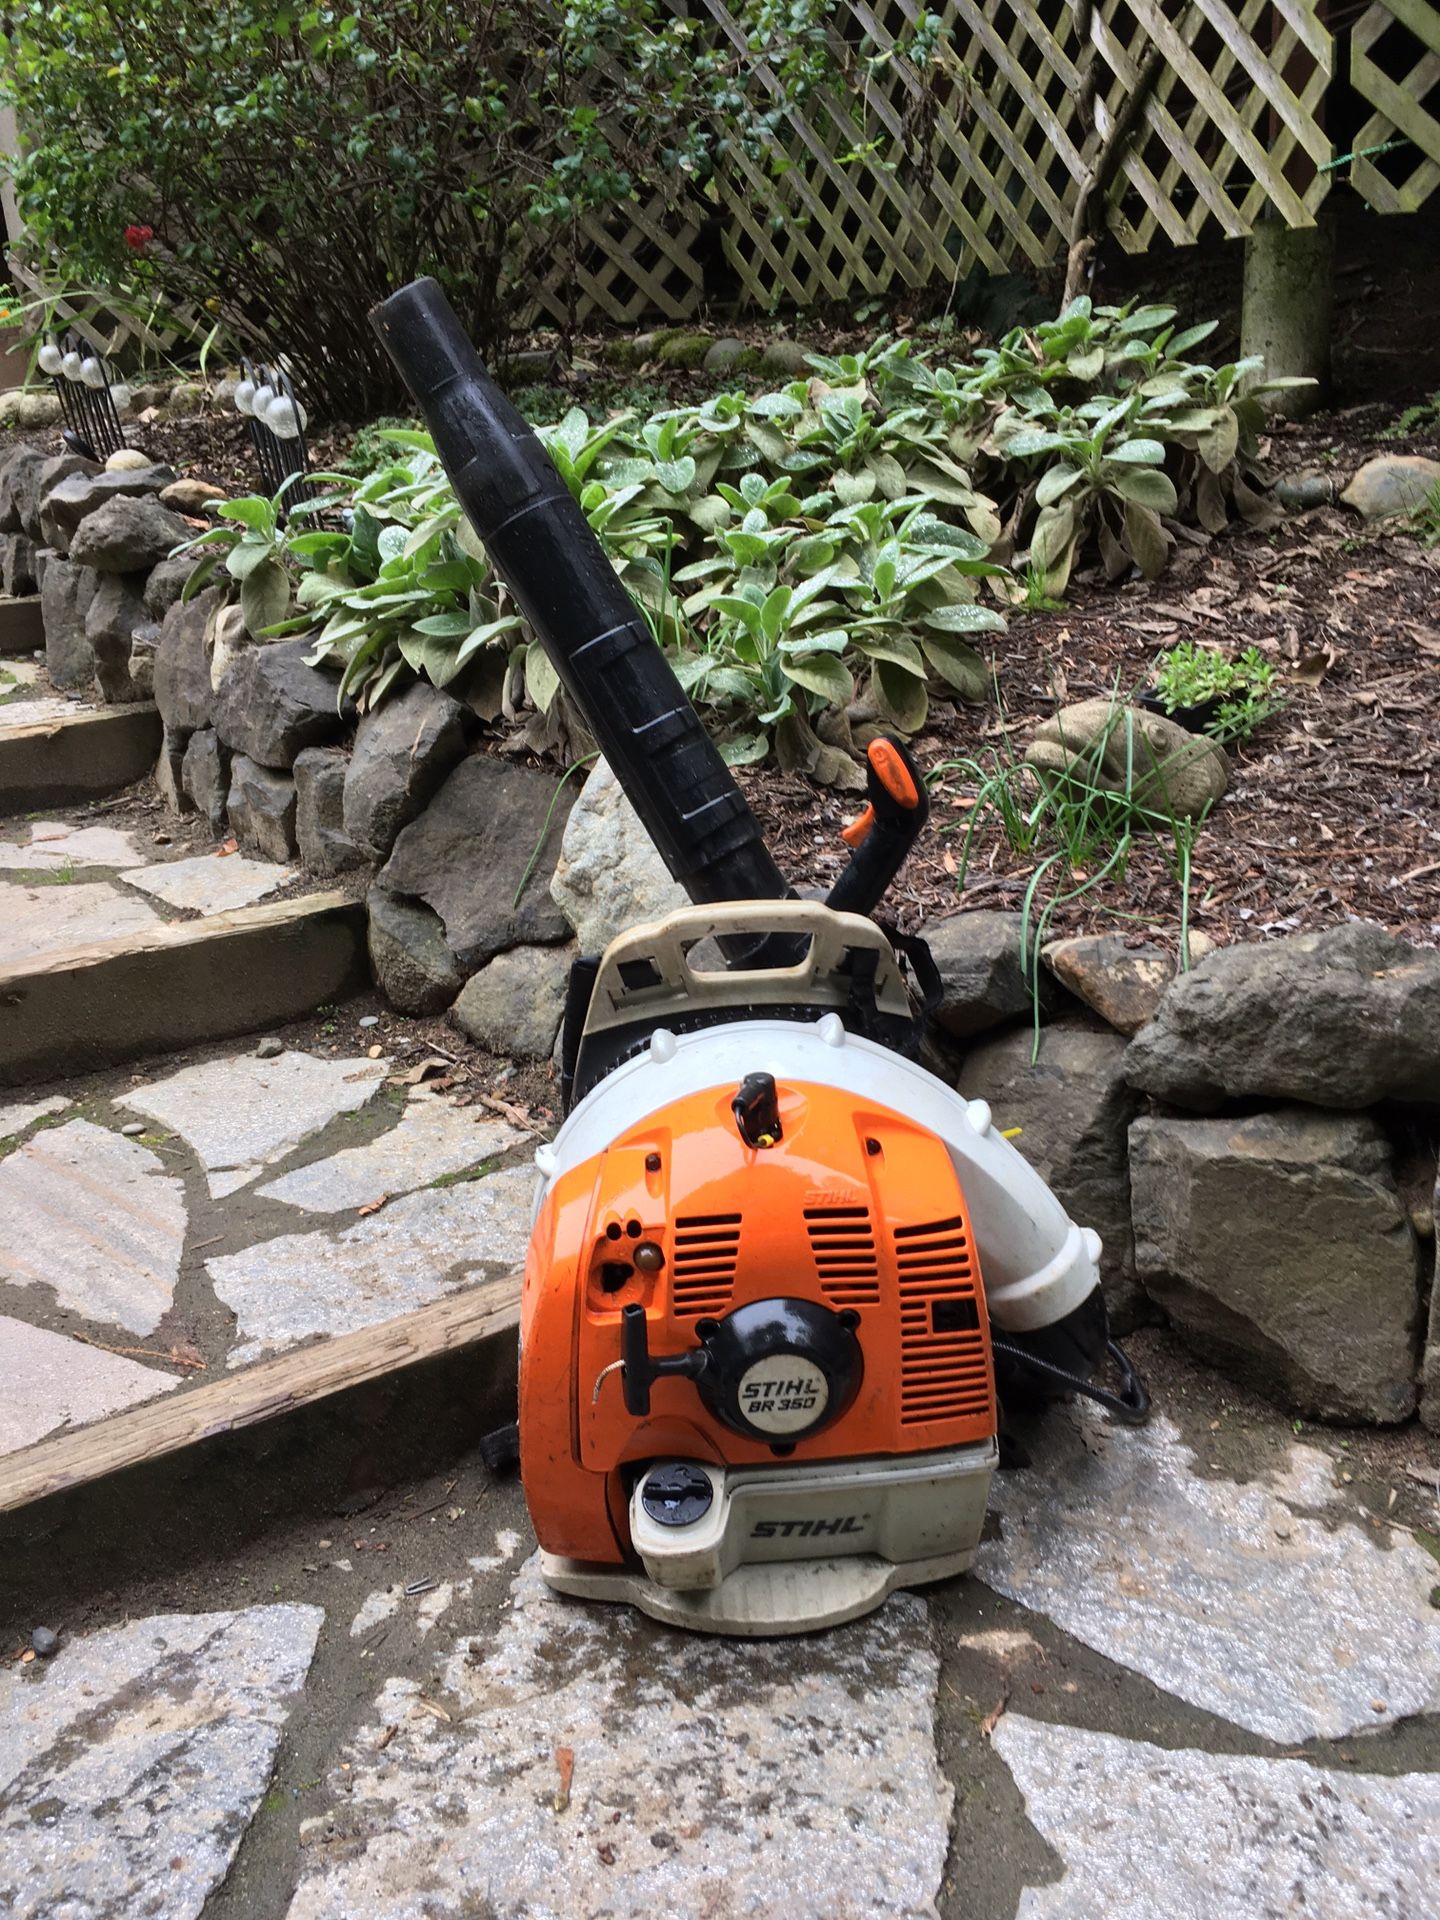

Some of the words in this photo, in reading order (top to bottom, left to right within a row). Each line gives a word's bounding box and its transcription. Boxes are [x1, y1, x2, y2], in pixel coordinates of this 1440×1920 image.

[803, 1189, 857, 1205] STIHL
[742, 1378, 819, 1399] STIHL
[748, 1400, 775, 1413] BR
[777, 1397, 816, 1411] 350
[750, 1516, 864, 1538] STIHL
